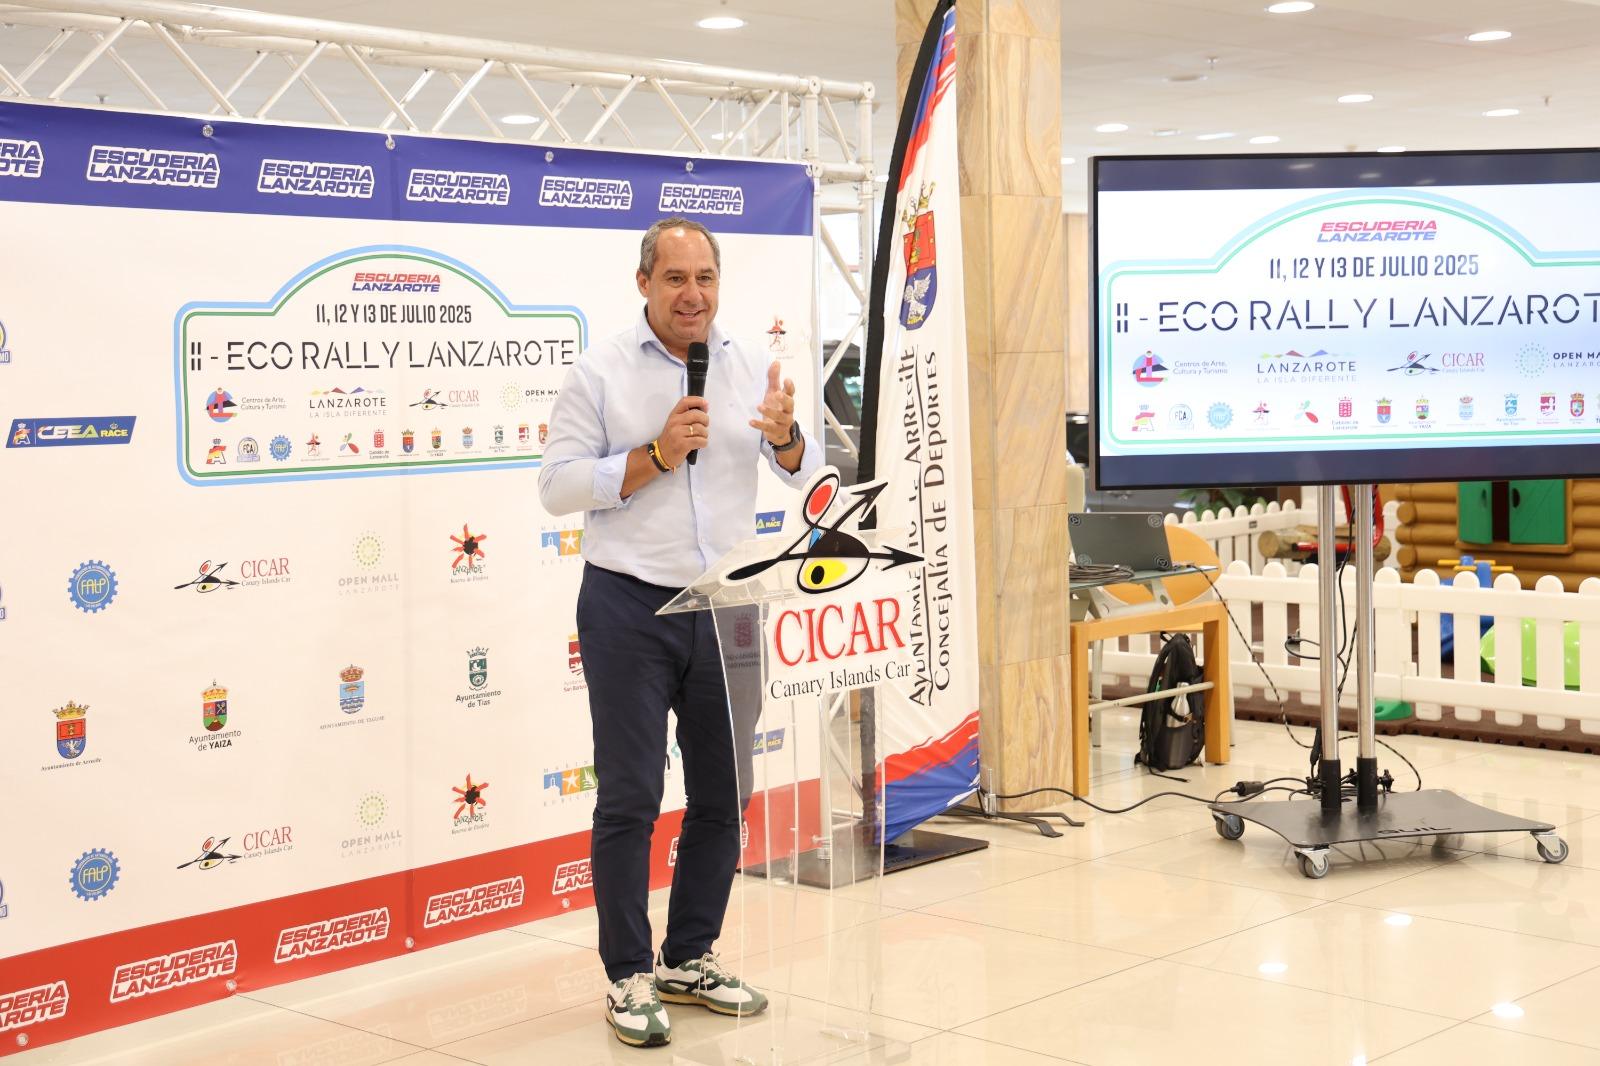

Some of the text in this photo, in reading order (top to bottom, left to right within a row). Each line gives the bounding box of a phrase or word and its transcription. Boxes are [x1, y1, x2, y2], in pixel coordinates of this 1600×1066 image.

[93, 149, 218, 171] ESCUDERIA
[89, 163, 217, 185] LANZAROTE
[262, 163, 373, 182] ESCUDERIA
[260, 177, 372, 195] LANZAROTE
[412, 172, 509, 190] ESCUDERIA
[543, 180, 631, 195] ESCUDERIA
[409, 186, 507, 202] LANZAROTE
[541, 192, 629, 207] LANZAROTE
[661, 186, 742, 201] ESCUDERIA
[660, 198, 741, 212] LANZAROTE
[1320, 220, 1437, 233] ESCUDERIA
[1317, 231, 1435, 243] LANZAROTE
[1293, 257, 1309, 279] 12
[1315, 257, 1327, 279] Y
[1330, 257, 1347, 279] 13
[1353, 256, 1375, 278] DE
[1380, 255, 1428, 277] JULIO
[1433, 254, 1479, 276] 2025
[353, 272, 441, 284] ESCUDERIA
[351, 282, 441, 292] LANZAROTE
[334, 304, 347, 324] 12
[351, 304, 362, 323] Y
[363, 304, 376, 323] 13
[380, 304, 397, 323] DE
[400, 304, 436, 323] JULIO
[439, 304, 472, 324] 2025
[1159, 301, 1239, 332] ECO
[1250, 298, 1377, 331] RALLY
[1389, 292, 1600, 328] LANZAROT
[227, 341, 294, 371] ECO
[302, 341, 400, 370] RALLY
[409, 339, 574, 368] LANZAROTE
[1442, 352, 1485, 368] CICAR
[1553, 352, 1582, 360] OPEN
[1257, 361, 1357, 373] LANZAROTE
[1257, 374, 1357, 384] LA ISLA DIFERENTE
[449, 389, 480, 403] CICAR
[525, 389, 545, 397] OPEN
[309, 397, 387, 409] LANZAROTE
[344, 409, 387, 418] DIFERENTE
[100, 429, 128, 438] RACE
[240, 557, 290, 579] CICAR
[338, 573, 400, 587] OPEN MALL
[774, 597, 906, 667] CICAR
[770, 660, 912, 700] Canary Islands Car
[455, 689, 502, 703] Ayuntamiento
[467, 700, 476, 708] de
[188, 729, 242, 745] Ayuntamiento
[197, 739, 233, 752] de YAIZA
[243, 826, 293, 851] CICAR
[341, 830, 402, 850] OPEN MALL
[429, 880, 523, 911] ESCUDERIA
[426, 892, 523, 925] LANZAROTE
[280, 912, 388, 946] ESCUDERIA
[277, 925, 388, 960] LANZAROTE
[115, 943, 236, 984] ESCUDERIA
[112, 959, 235, 999] LANZAROTE
[0, 984, 66, 1013] DERIA
